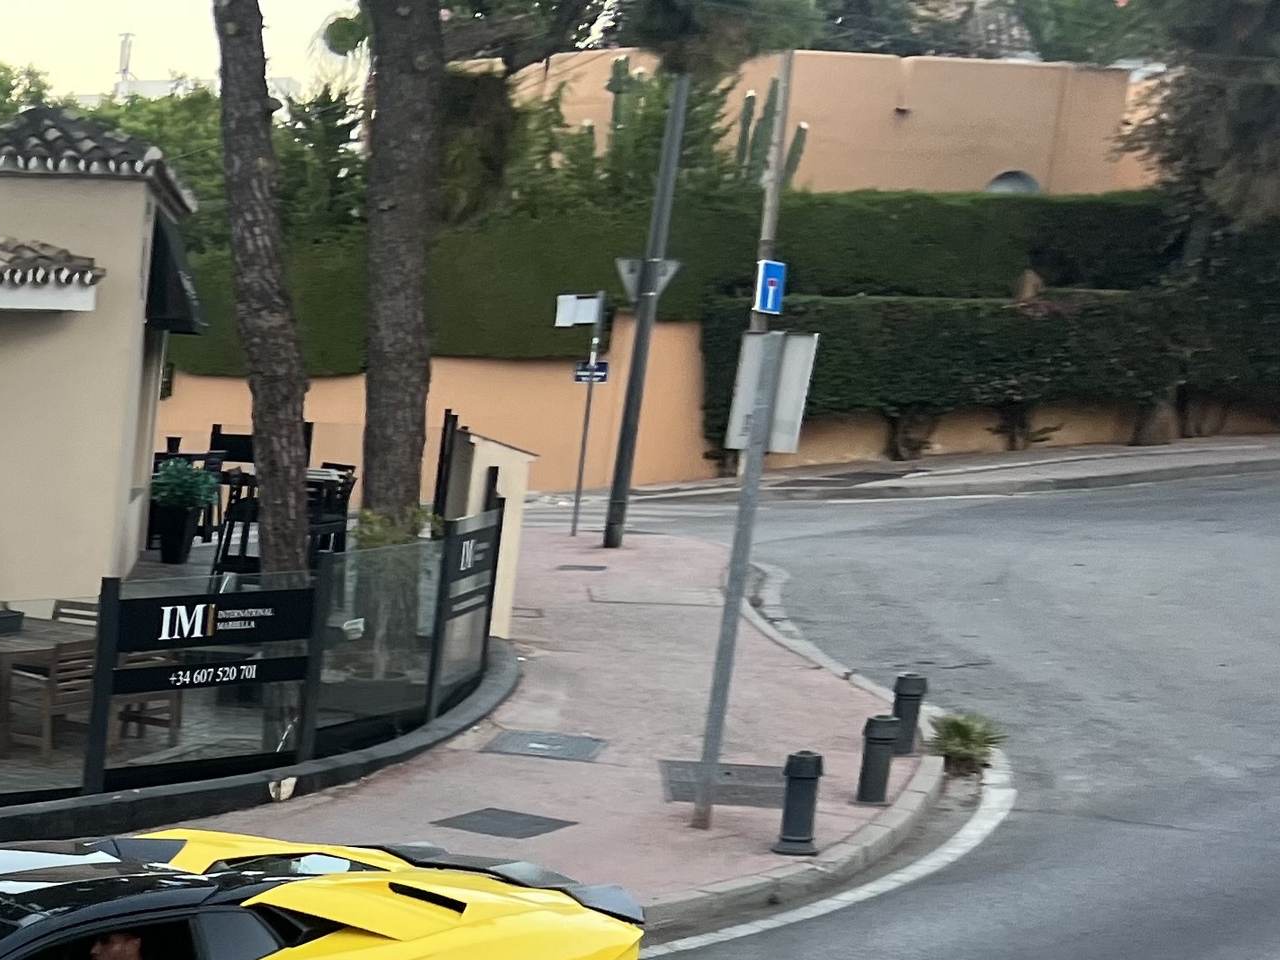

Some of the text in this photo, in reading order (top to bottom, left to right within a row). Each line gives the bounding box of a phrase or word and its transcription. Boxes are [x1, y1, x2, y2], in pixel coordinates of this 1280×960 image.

[218, 607, 274, 619] INTERNATIONAL
[158, 604, 208, 640] IM
[217, 621, 256, 630] MARBELLA
[169, 665, 257, 686] +34 607 520 701
